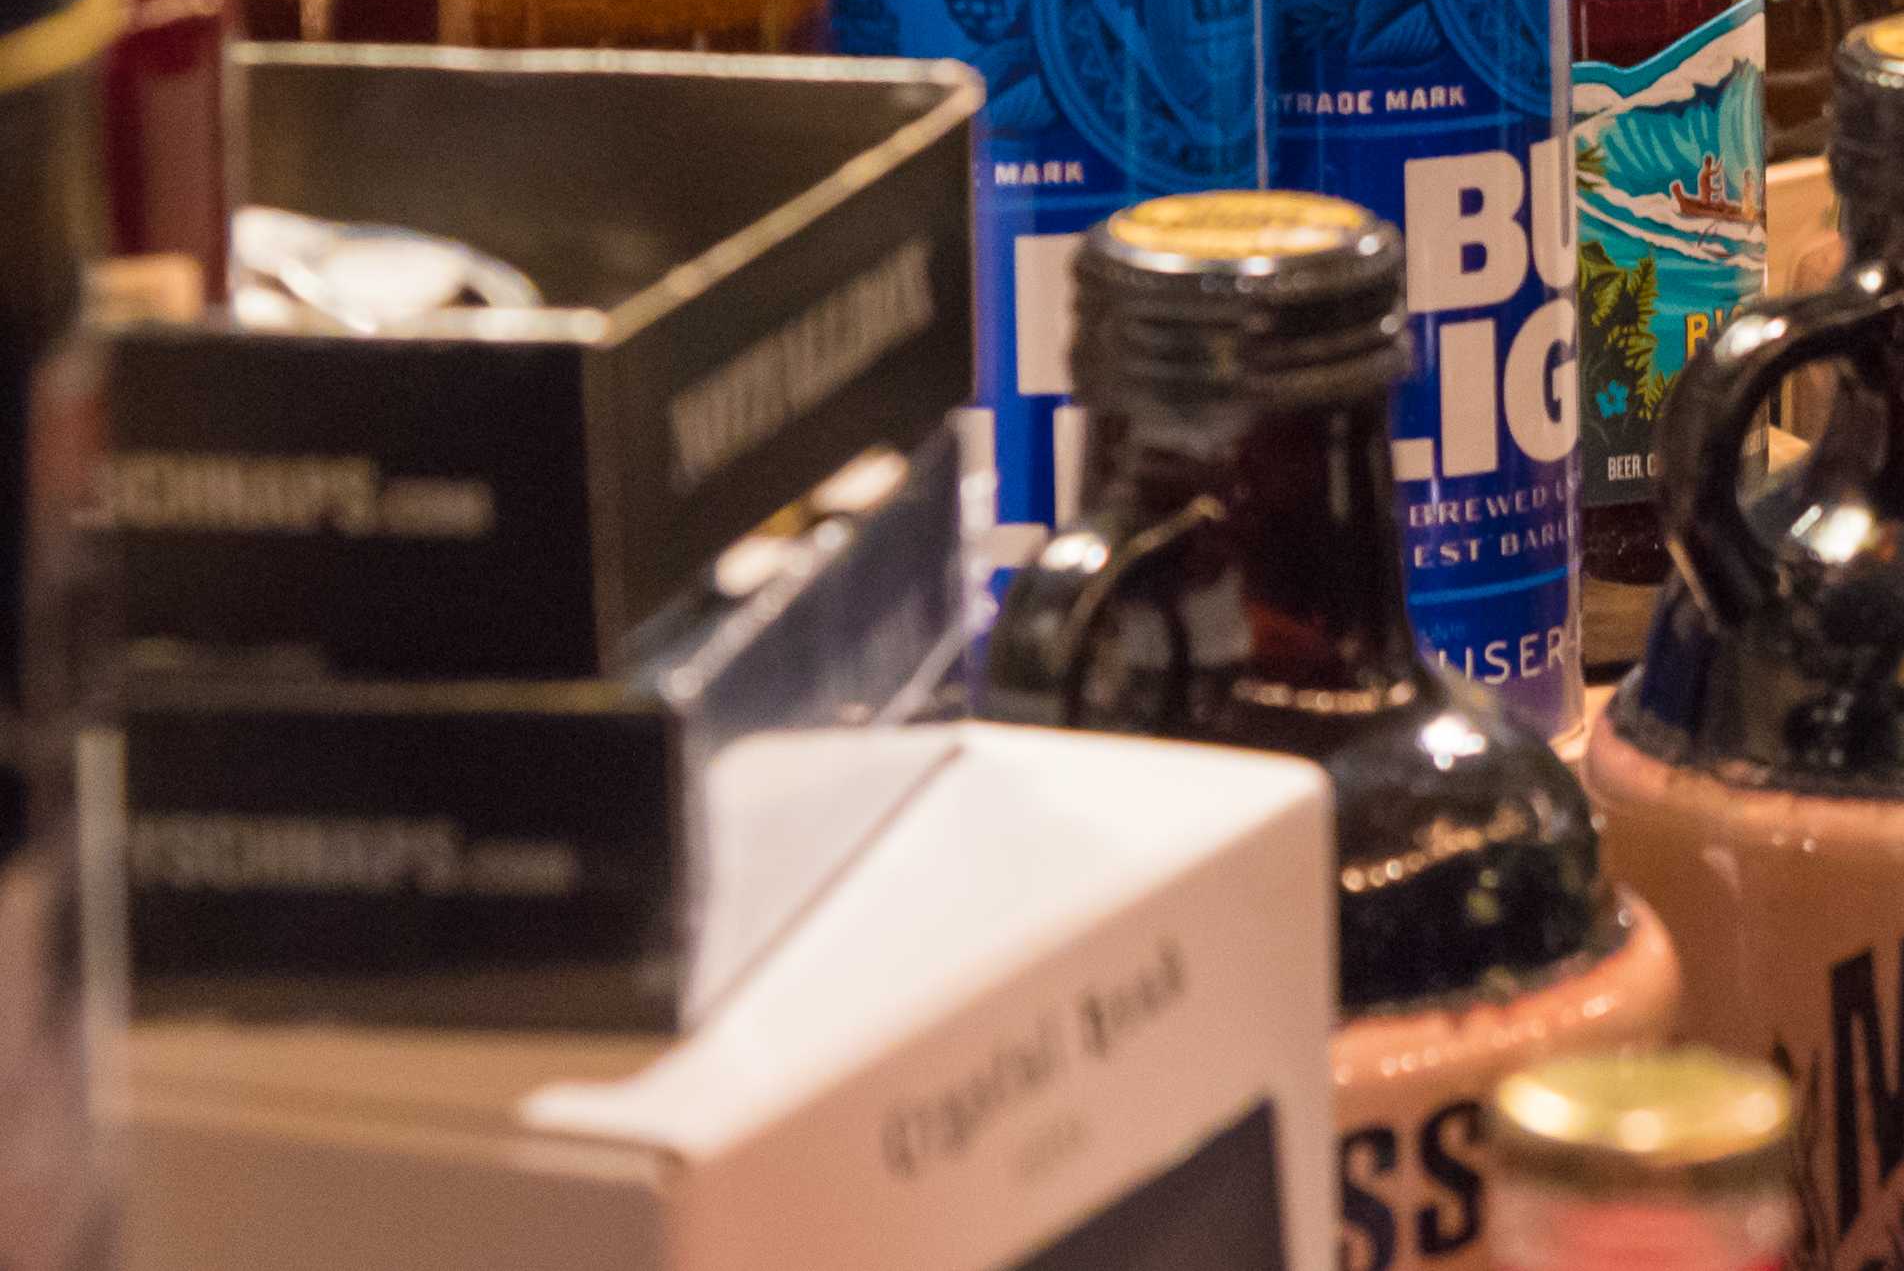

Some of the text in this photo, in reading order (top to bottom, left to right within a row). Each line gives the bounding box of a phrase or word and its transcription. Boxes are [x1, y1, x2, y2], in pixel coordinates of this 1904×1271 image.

[1385, 84, 1467, 112] MARK
[994, 161, 1085, 185] MARK
[1409, 485, 1550, 528] BREWED
